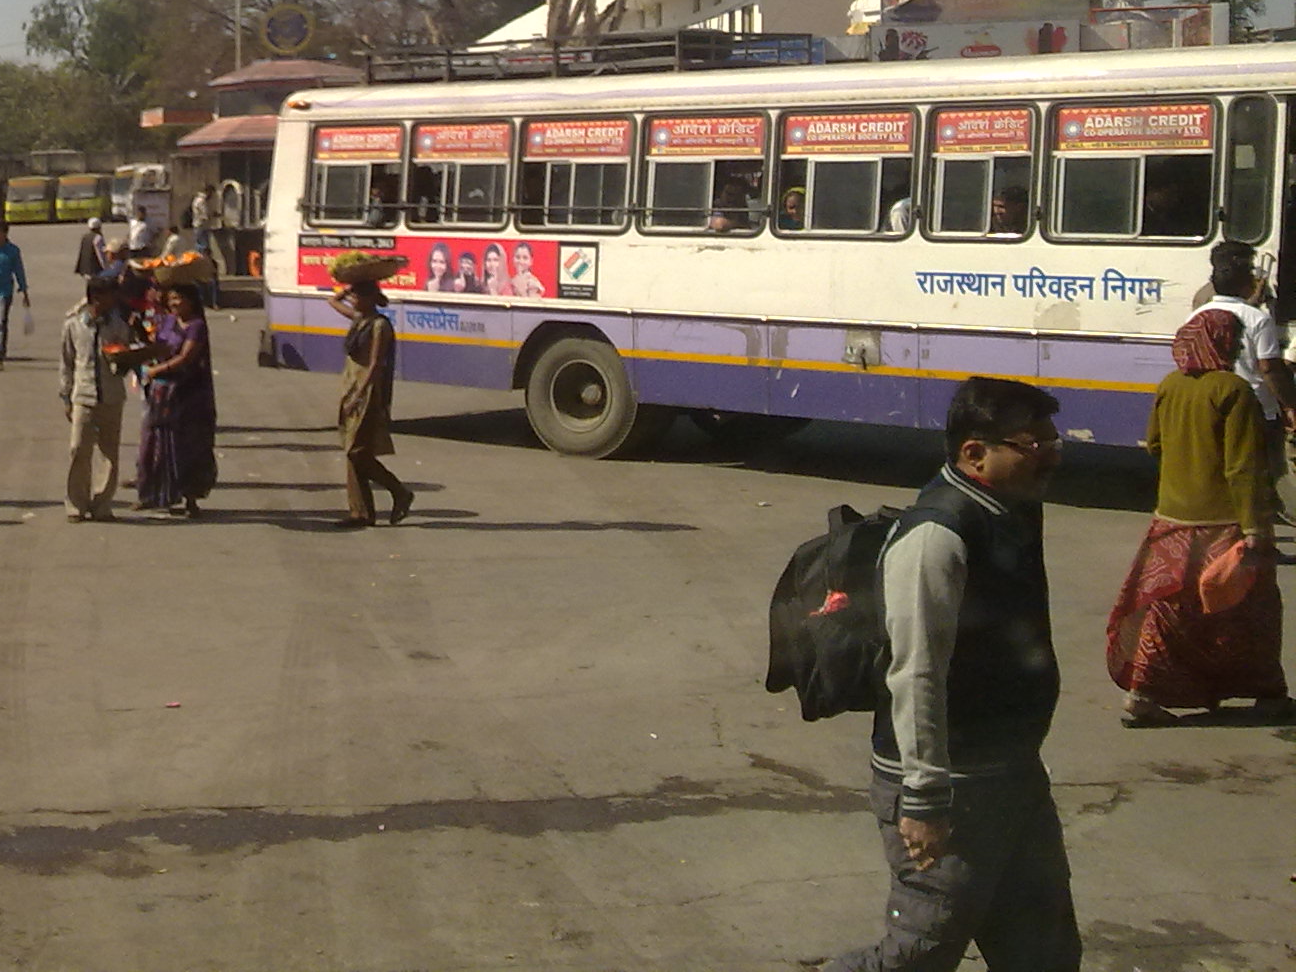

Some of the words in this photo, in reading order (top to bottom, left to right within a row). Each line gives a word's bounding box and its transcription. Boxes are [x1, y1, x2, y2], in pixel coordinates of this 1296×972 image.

[808, 122, 856, 134] ADARSH
[859, 121, 905, 133] CREDIT
[1084, 116, 1144, 128] ADARSH
[1148, 114, 1203, 127] CREDIT
[545, 128, 586, 138] ADARSH
[587, 126, 625, 137] CREDIT
[915, 271, 1006, 297] राजस्थान
[1012, 267, 1096, 301] परिवहन
[1101, 268, 1165, 302] निगम
